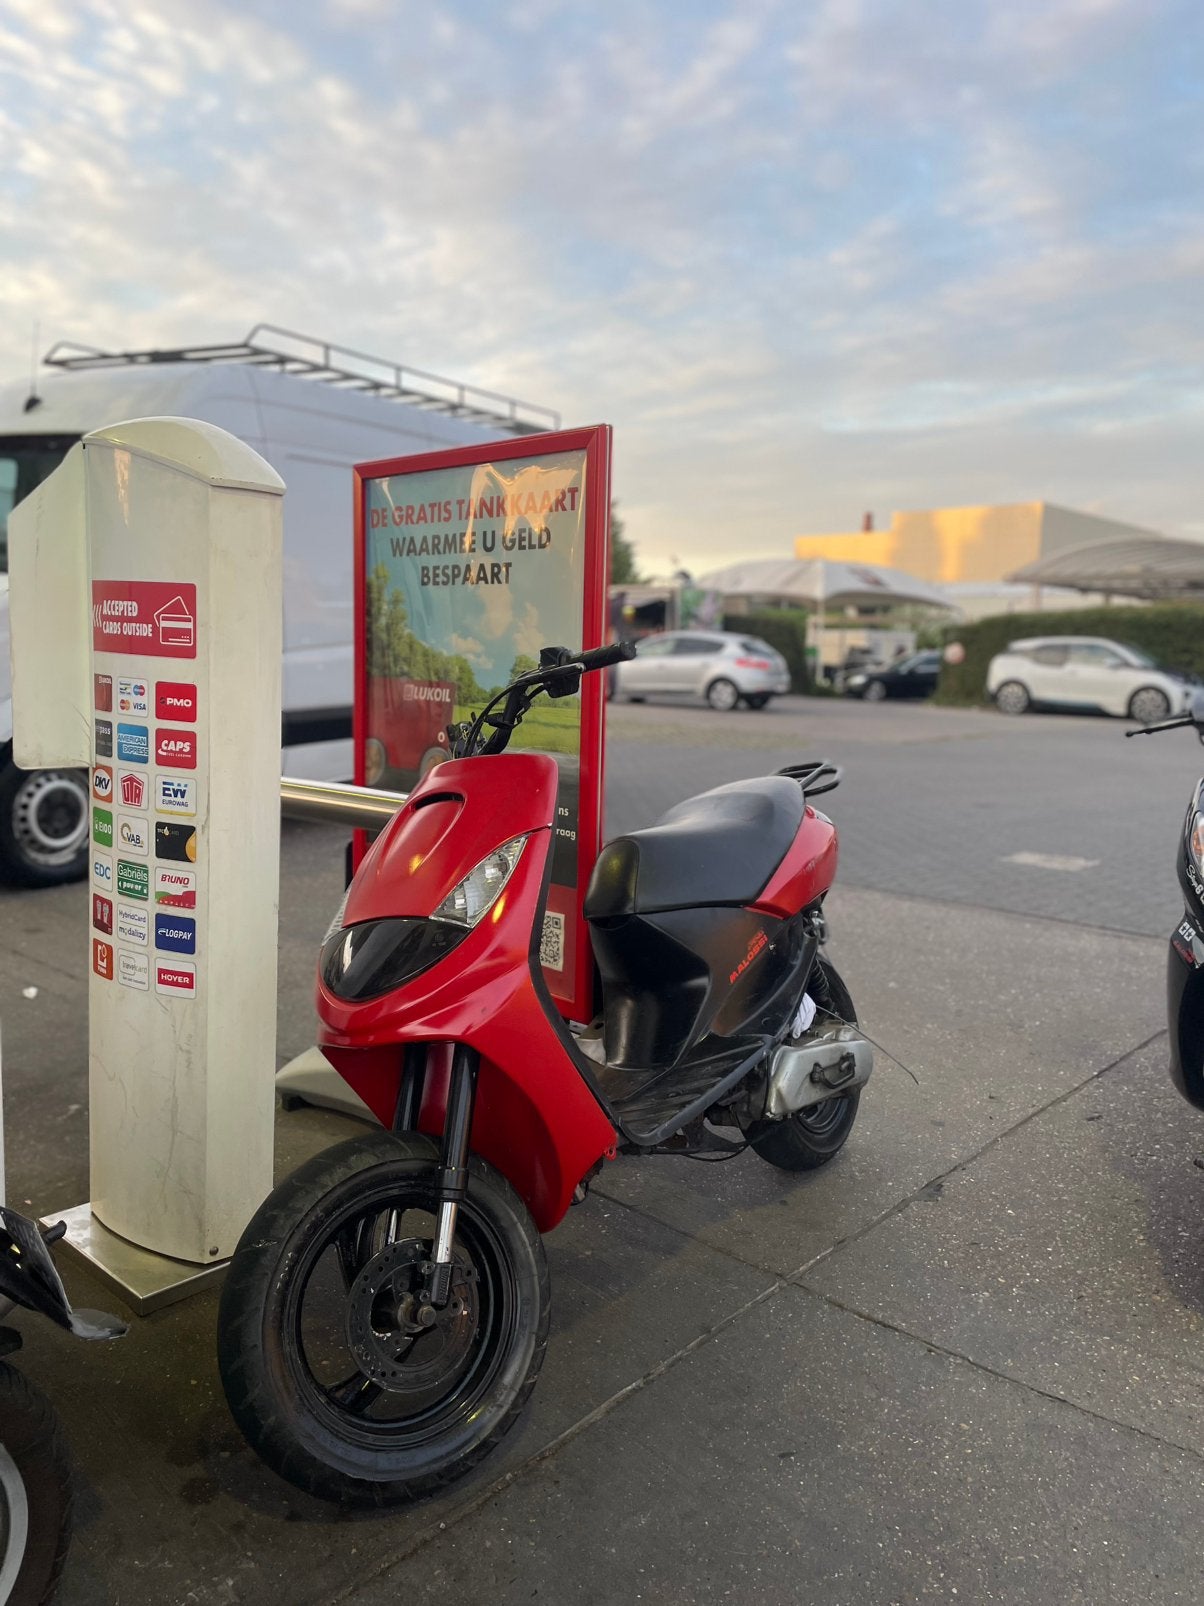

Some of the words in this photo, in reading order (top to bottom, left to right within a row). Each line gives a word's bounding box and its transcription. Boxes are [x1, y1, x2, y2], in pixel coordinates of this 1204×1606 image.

[371, 508, 387, 528] DE
[392, 500, 452, 527] GRATIS
[456, 487, 579, 521] TANKKAART
[390, 531, 476, 557] WAARMEE
[482, 530, 496, 553] U
[502, 526, 551, 551] GELD
[421, 562, 512, 586] BESPAART
[103, 600, 138, 617] ACCEPTED
[103, 621, 121, 635] CARDS
[123, 622, 153, 637] OUTSIDE
[413, 686, 451, 702] LUKOIL
[133, 701, 146, 711] VISA
[166, 697, 192, 707] PMO
[118, 734, 146, 746] AMERICAN
[161, 739, 191, 753] CAPS
[123, 744, 148, 757] EXPRESS
[95, 775, 110, 790] DKV
[162, 799, 188, 808] EUROWAG
[126, 832, 141, 844] VAB
[94, 862, 111, 880] EDC
[118, 864, 148, 882] Gabriëls
[161, 873, 190, 885] BRUNO
[119, 909, 146, 923] HybridCard
[165, 928, 192, 941] LOGPAY
[161, 973, 190, 984] HOYER
